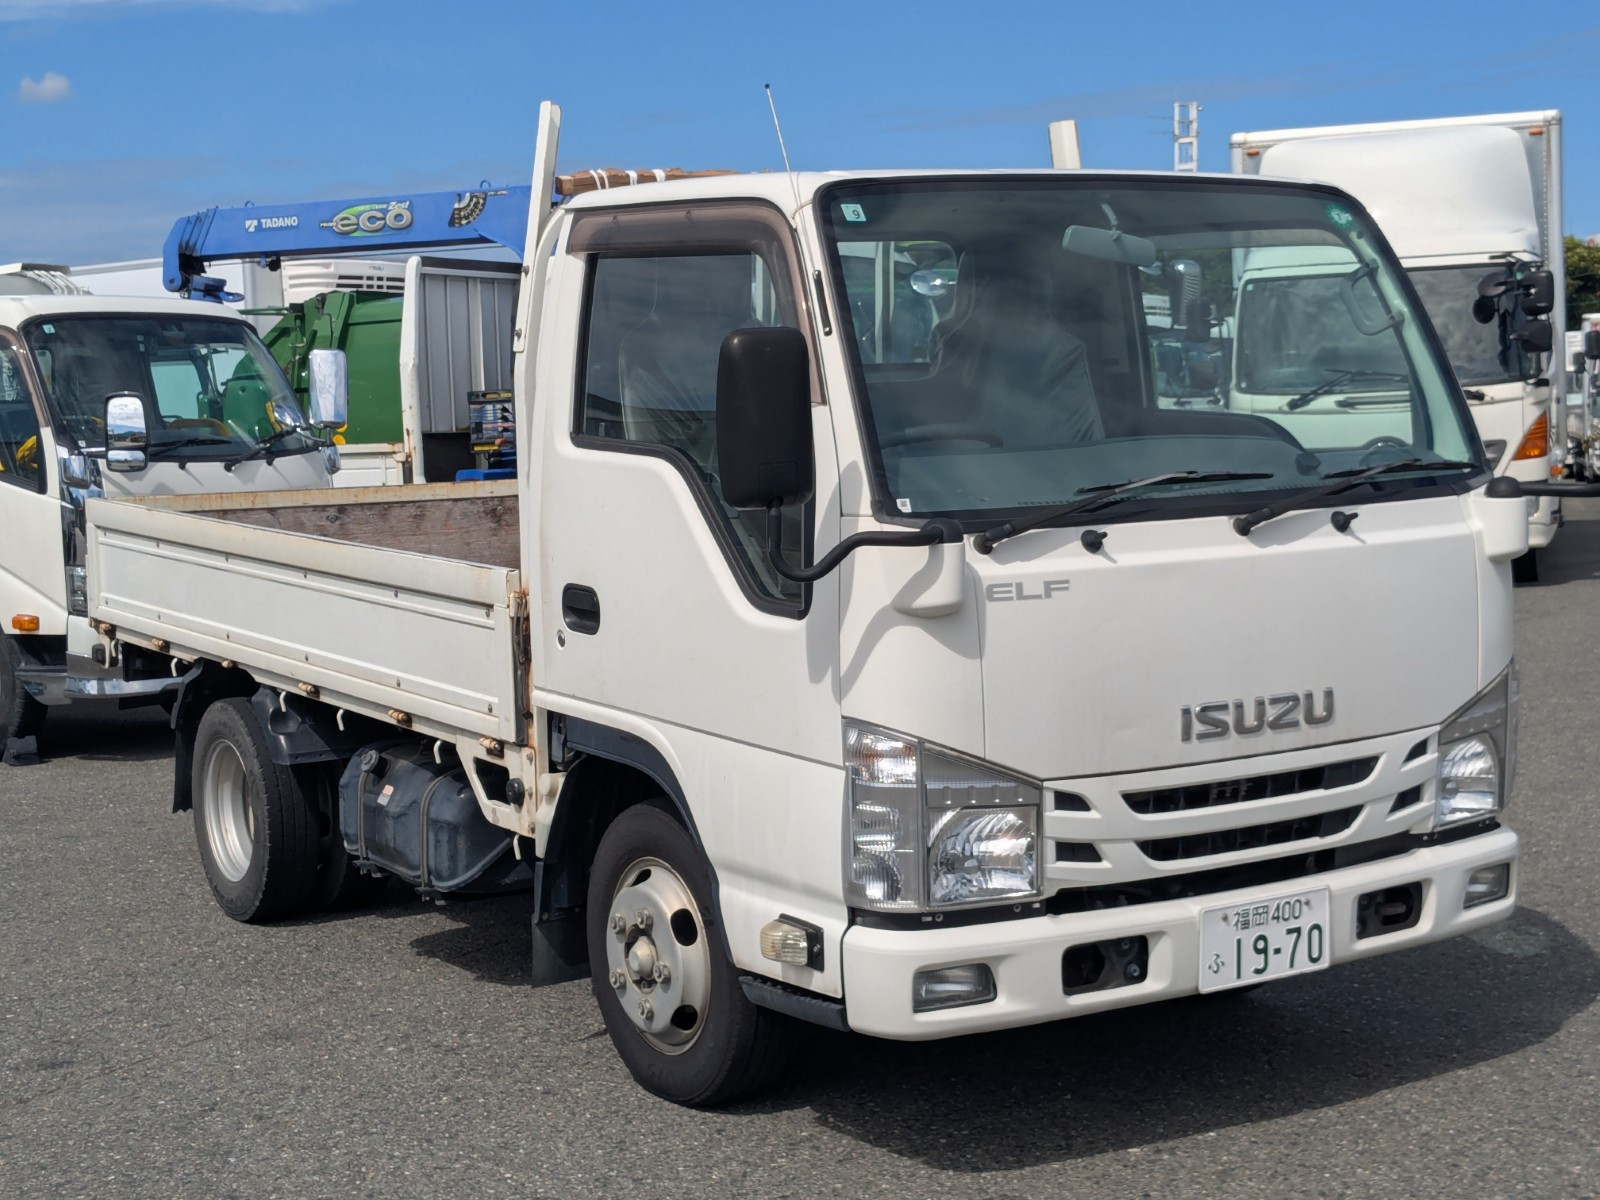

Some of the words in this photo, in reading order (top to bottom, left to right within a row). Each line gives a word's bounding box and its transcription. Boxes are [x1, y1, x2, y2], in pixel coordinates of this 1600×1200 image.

[260, 216, 299, 229] TADANO
[332, 207, 413, 235] eco
[985, 579, 1070, 602] ELF
[1180, 686, 1334, 742] ISUZU
[1207, 953, 1225, 974] ふ
[1235, 922, 1323, 980] 19-70
